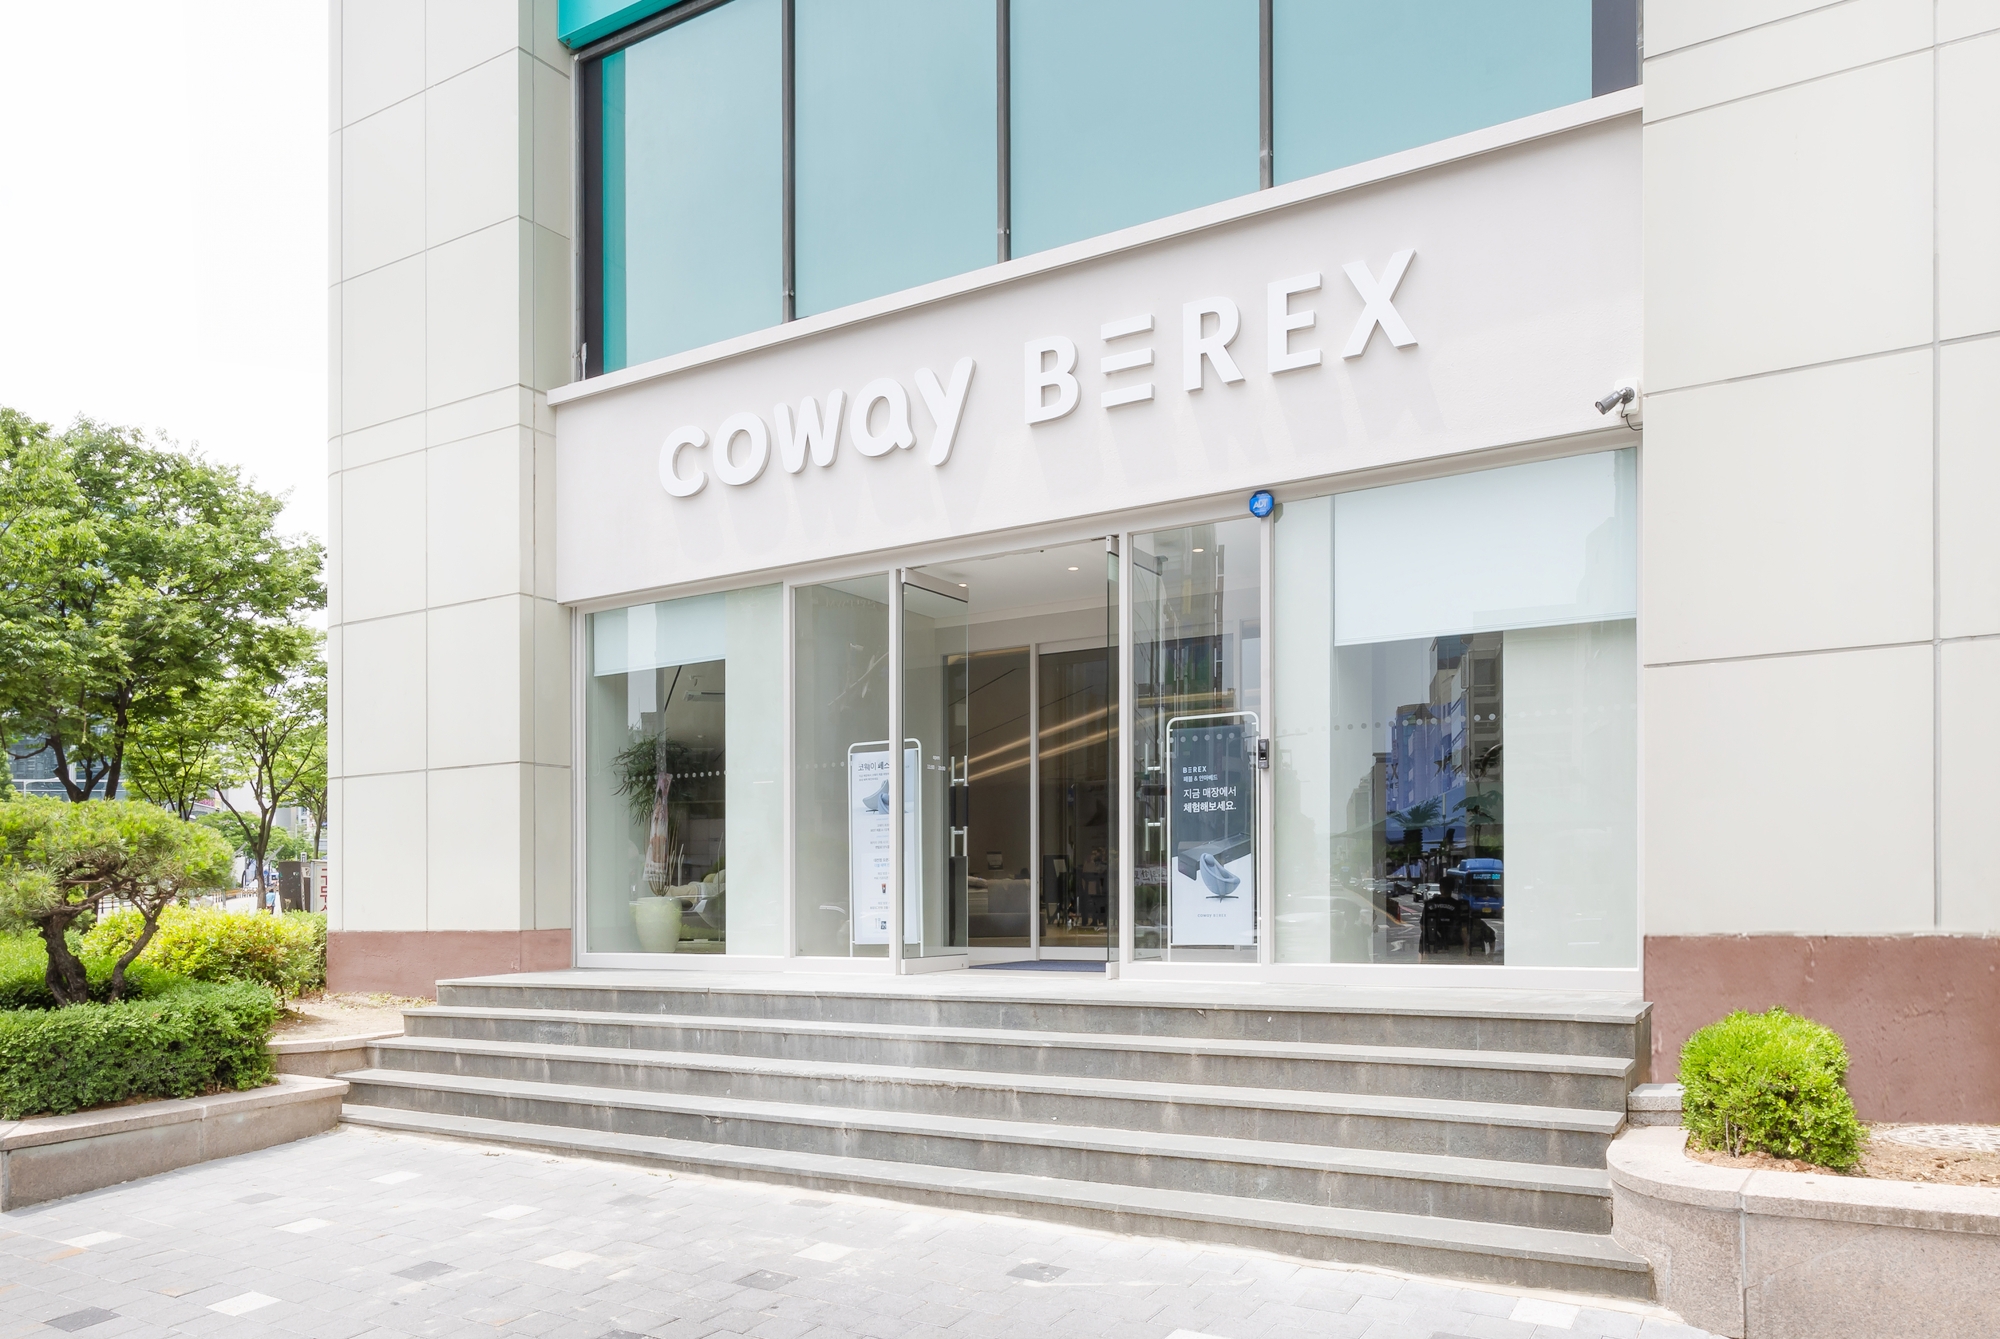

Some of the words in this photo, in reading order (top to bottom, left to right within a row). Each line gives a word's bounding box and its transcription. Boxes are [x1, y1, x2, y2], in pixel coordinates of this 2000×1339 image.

[1024, 248, 1418, 426] BEREX
[1253, 499, 1268, 509] ADT
[858, 762, 877, 771] 코웨이
[1182, 765, 1207, 774] BEREX
[1183, 788, 1200, 799] 지금
[1202, 785, 1237, 798] 매장에서
[1183, 800, 1237, 813] 체험해보세요.
